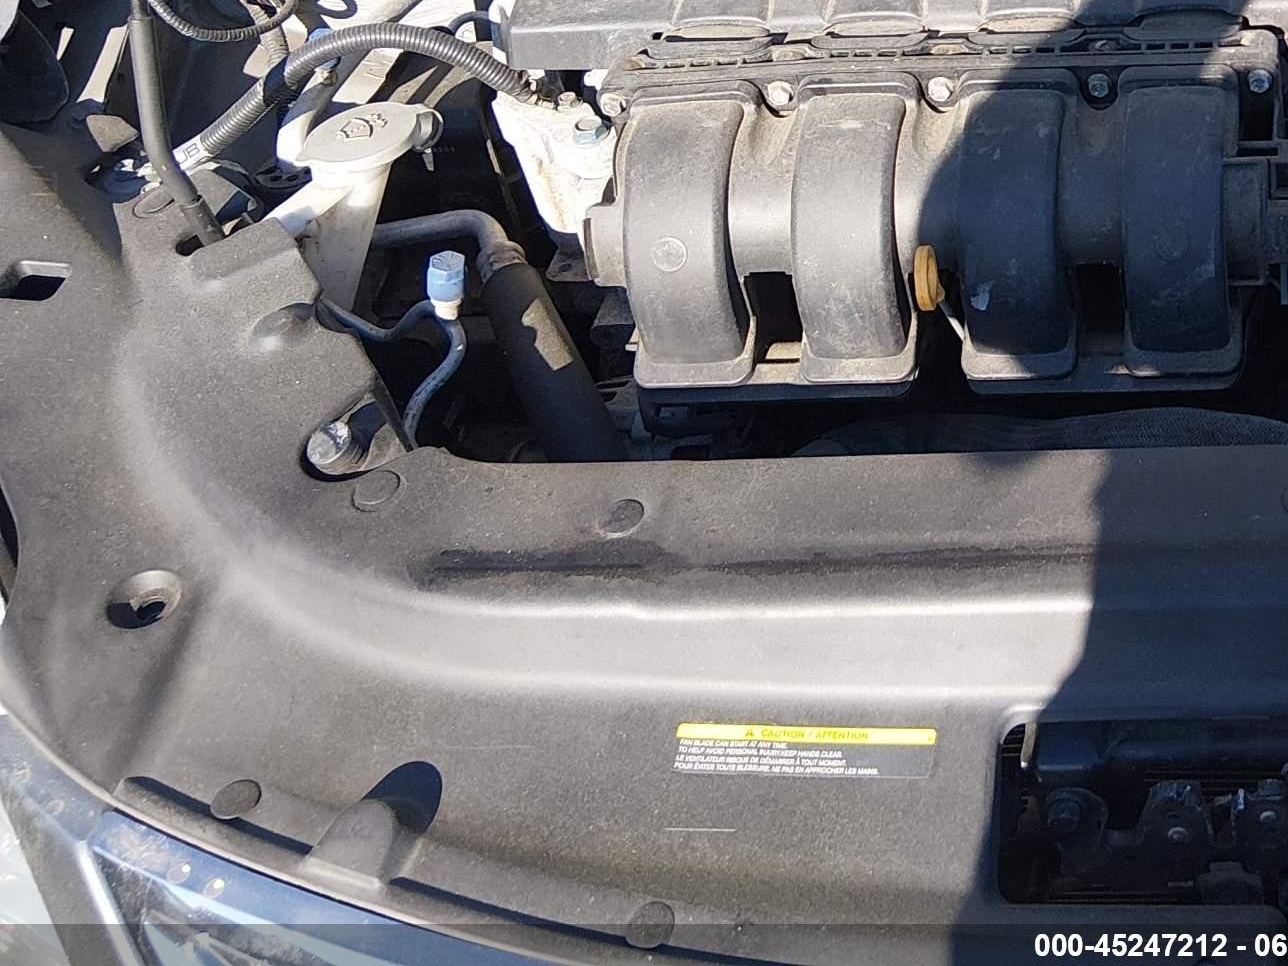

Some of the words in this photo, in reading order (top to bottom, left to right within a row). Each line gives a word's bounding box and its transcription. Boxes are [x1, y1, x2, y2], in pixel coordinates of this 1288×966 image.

[761, 729, 805, 739] CAUTION
[815, 731, 869, 740] ATTENTION
[688, 746, 705, 754] HELP
[685, 754, 725, 762] VENTILATEUR
[673, 761, 693, 769] POUR
[715, 763, 737, 771] TOUTE
